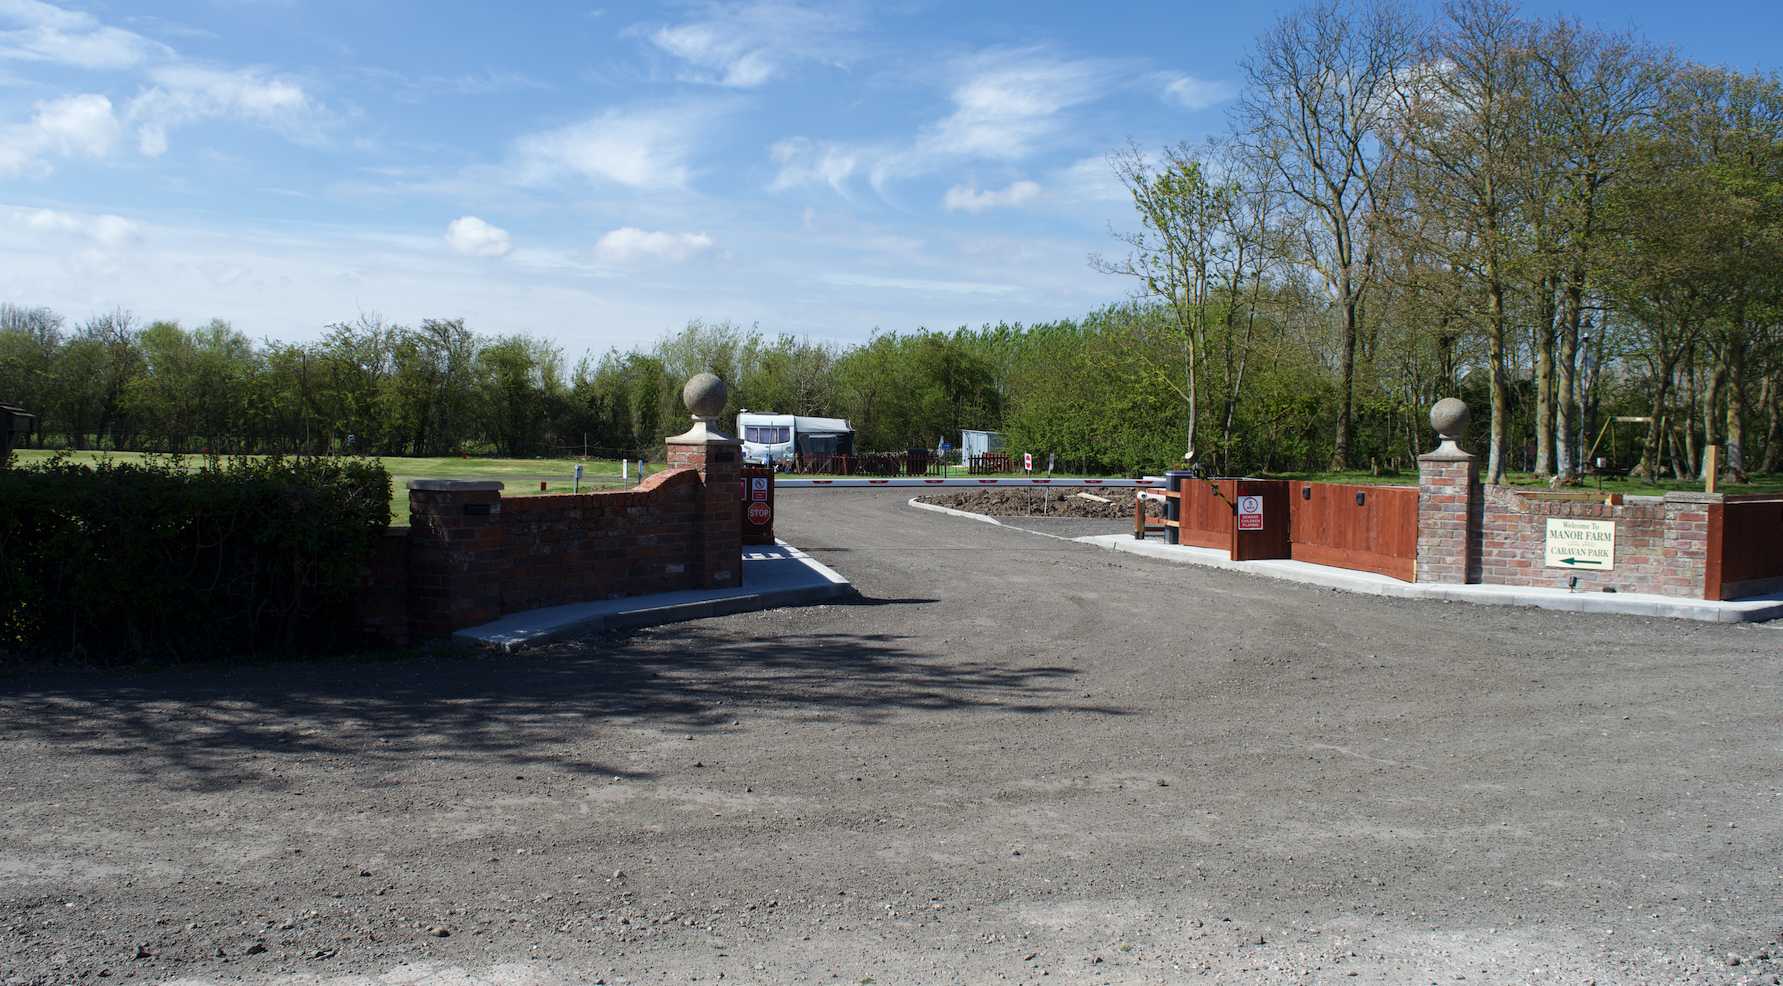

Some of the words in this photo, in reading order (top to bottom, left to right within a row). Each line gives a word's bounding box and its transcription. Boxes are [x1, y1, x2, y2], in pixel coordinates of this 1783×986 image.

[749, 509, 769, 517] STOP
[1563, 521, 1590, 530] Welcome
[1591, 522, 1599, 530] To
[1549, 529, 1583, 540] MANOR
[1585, 531, 1612, 542] FARM
[1550, 546, 1586, 556] CARAVAN
[1587, 548, 1609, 557] PARK
